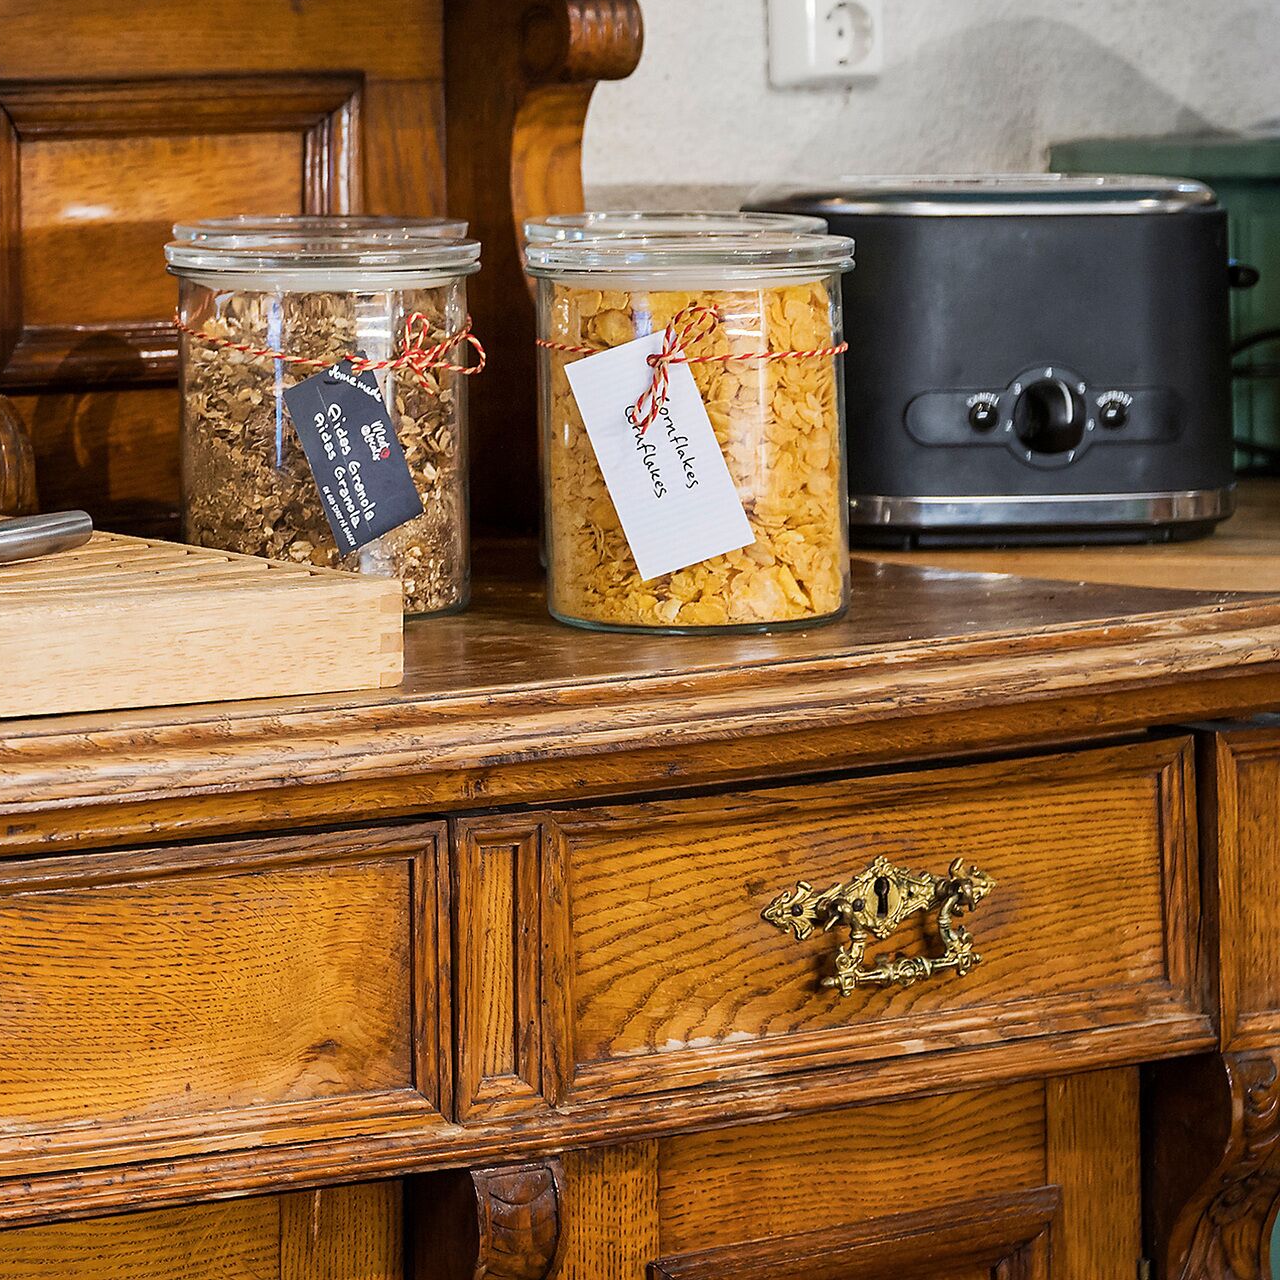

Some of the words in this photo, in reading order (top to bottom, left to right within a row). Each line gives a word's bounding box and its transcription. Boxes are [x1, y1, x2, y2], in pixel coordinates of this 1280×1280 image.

[313, 412, 337, 461] Aidas
[334, 466, 363, 530] Granola
[327, 403, 352, 456] Aidas
[348, 460, 377, 522] Granola
[656, 396, 699, 490] Cornflakes
